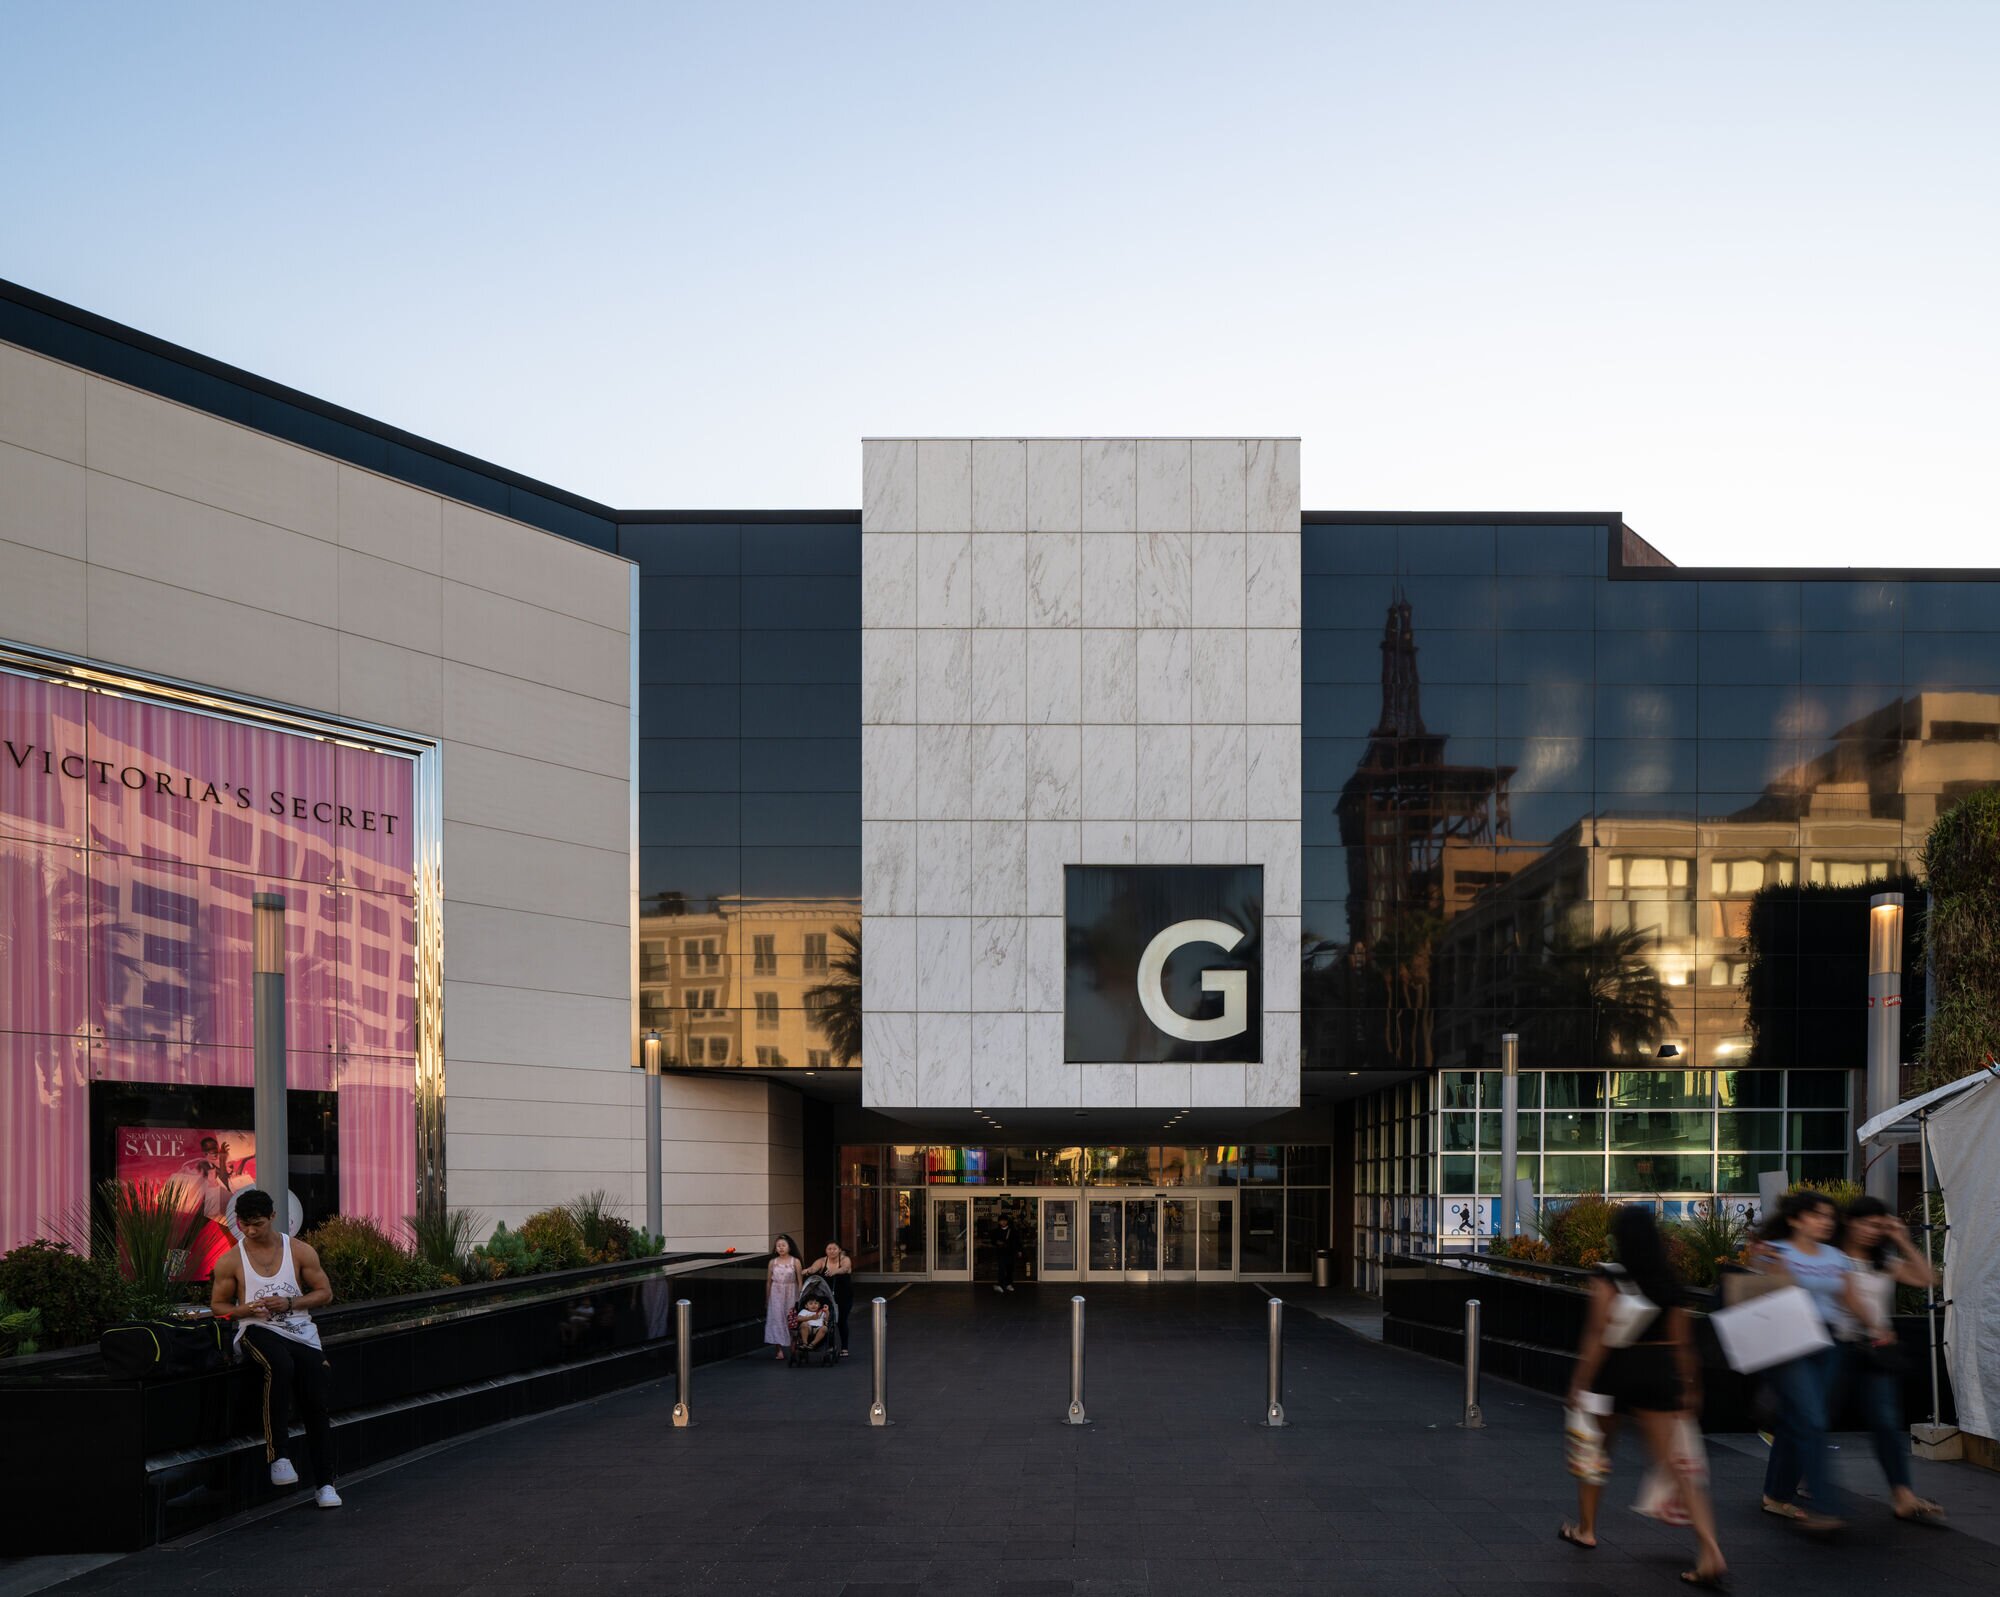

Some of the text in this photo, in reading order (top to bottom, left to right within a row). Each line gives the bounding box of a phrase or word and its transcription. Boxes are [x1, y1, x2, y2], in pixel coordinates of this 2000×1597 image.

[3, 740, 399, 835] VICTORIA'S SECRET
[1137, 919, 1247, 1042] G
[125, 1140, 185, 1156] SALE
